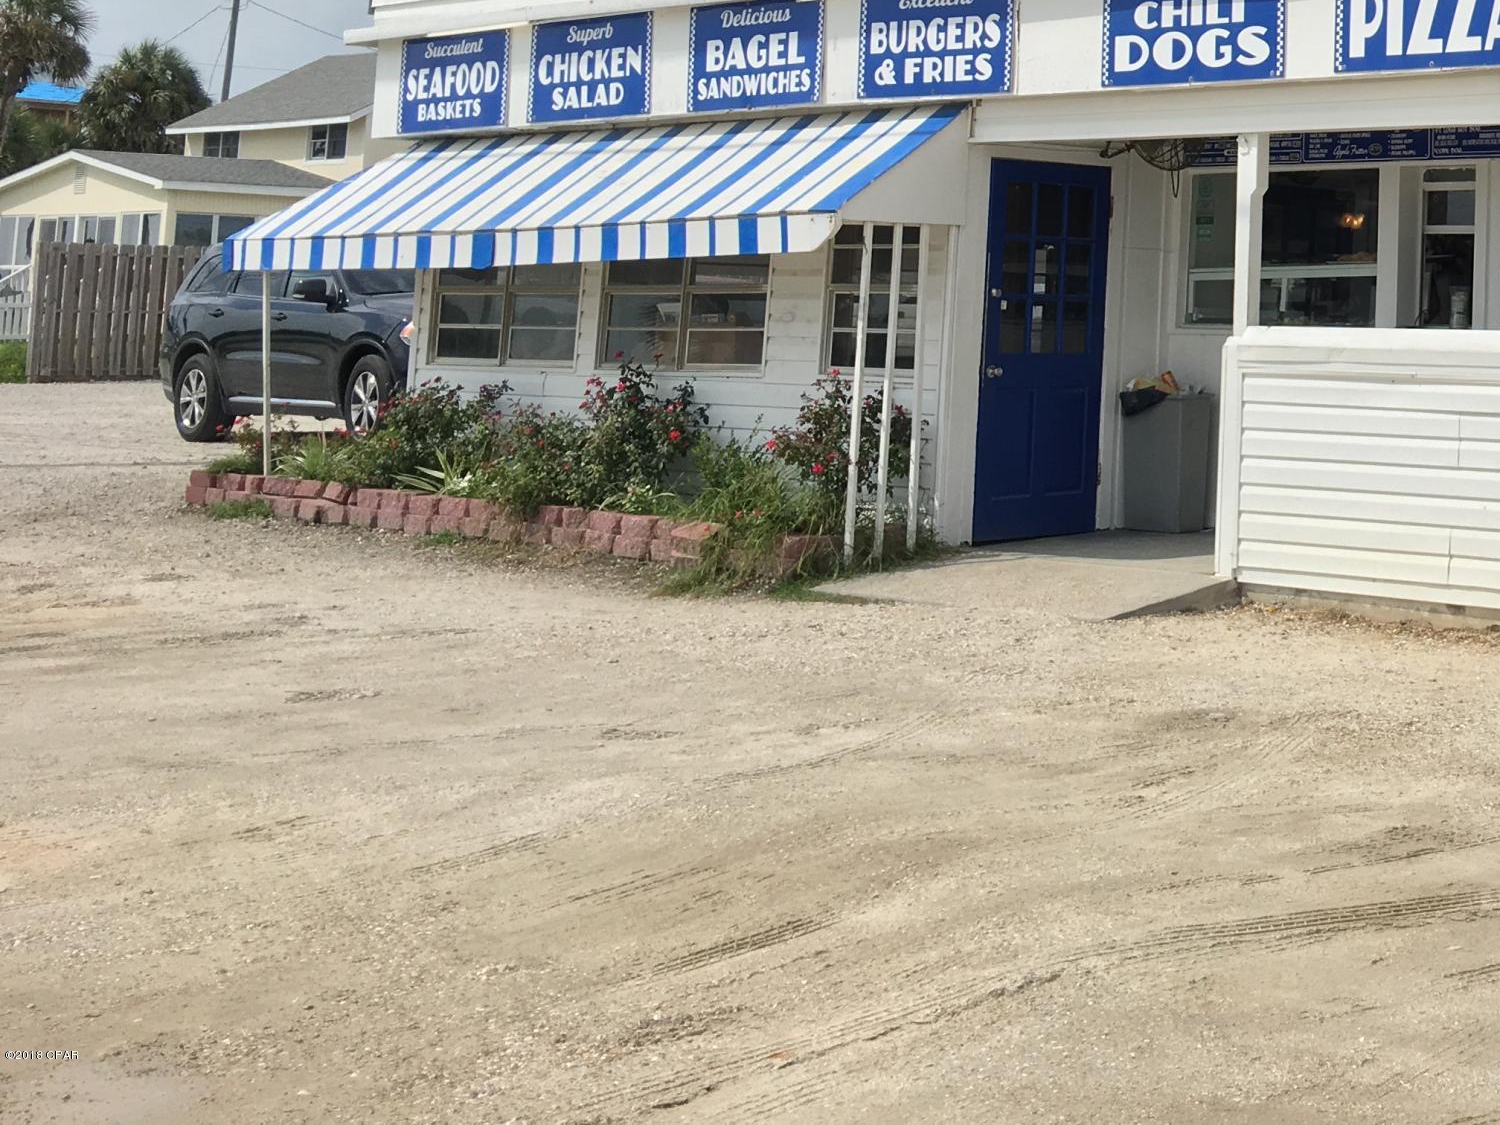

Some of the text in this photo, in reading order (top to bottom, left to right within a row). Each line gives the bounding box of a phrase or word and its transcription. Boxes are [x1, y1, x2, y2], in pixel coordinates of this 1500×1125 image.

[721, 5, 791, 30] Delicious
[424, 38, 483, 61] Succulent
[567, 22, 613, 47] Superb
[870, 14, 1001, 54] BURGERS
[1114, 25, 1270, 72] DOGS
[538, 45, 642, 84] CHICKEN
[706, 30, 805, 72] BAGEL
[407, 60, 500, 101] SEAFOOD
[697, 69, 810, 100] SANDWICHES
[874, 53, 992, 85] & FRIES
[417, 97, 481, 122] BASKETS
[552, 82, 624, 111] SALAD
